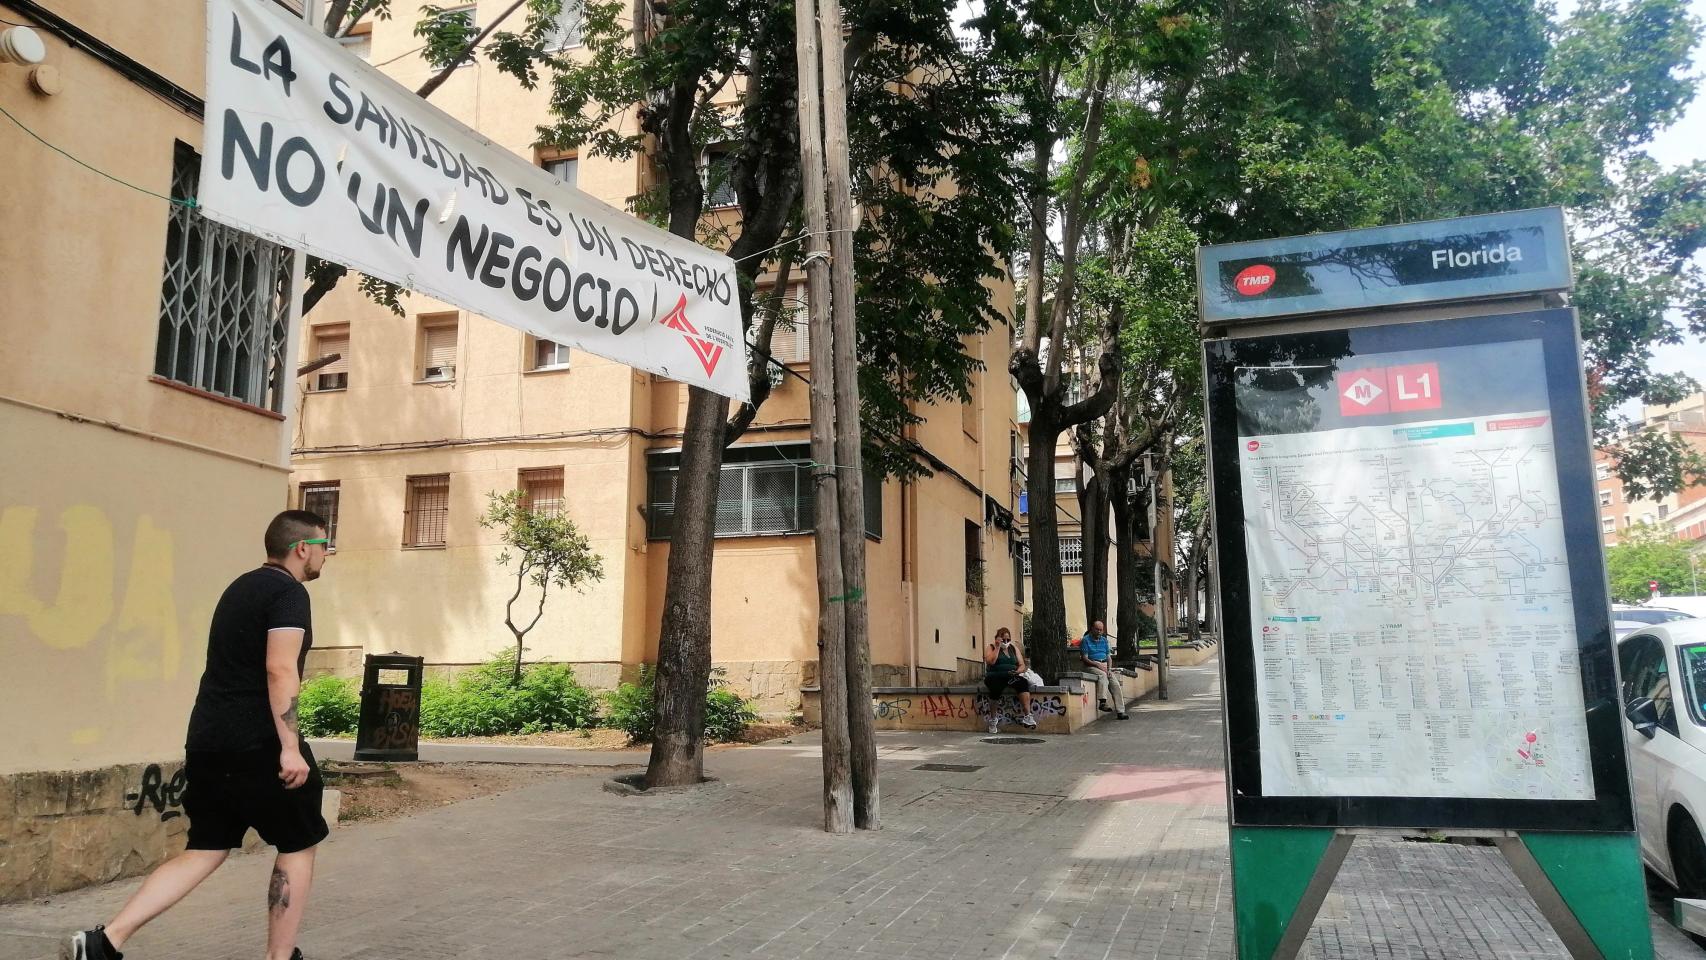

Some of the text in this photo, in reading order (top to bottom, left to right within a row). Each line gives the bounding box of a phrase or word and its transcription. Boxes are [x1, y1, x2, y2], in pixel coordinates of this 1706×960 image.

[230, 12, 731, 306] LA SANIDAD ES UN DERECHO
[221, 108, 326, 207] NO
[346, 171, 430, 258] UN
[446, 214, 640, 336] NEGOCIO
[1431, 243, 1523, 270] Florida
[1242, 275, 1270, 286] TMB
[1354, 385, 1372, 399] M
[1396, 373, 1431, 400] L1
